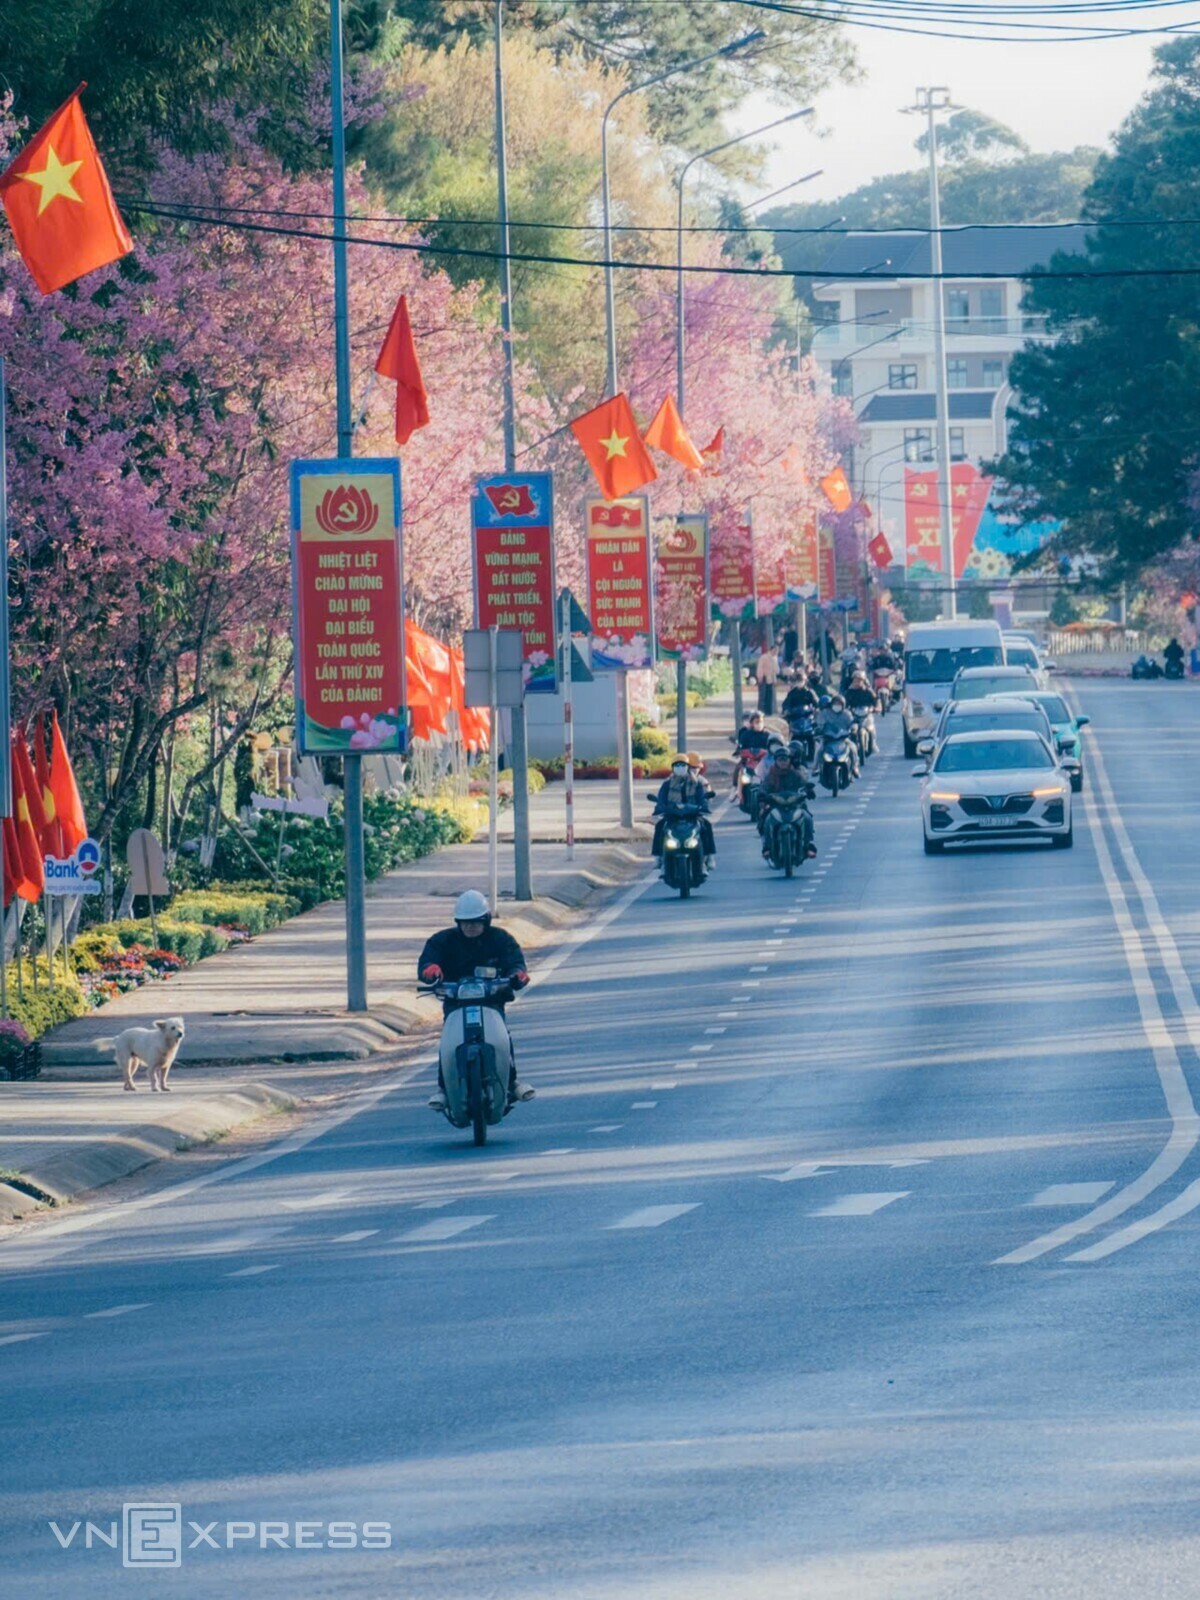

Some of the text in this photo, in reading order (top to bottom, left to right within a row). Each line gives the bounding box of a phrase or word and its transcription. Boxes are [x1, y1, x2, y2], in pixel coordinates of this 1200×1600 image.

[500, 529, 526, 546] ĐẢNG
[319, 551, 378, 571] NHIỆT LIỆT
[315, 573, 383, 591] CHÀO MỪNG
[329, 596, 371, 616] ĐẠI HỘI
[488, 591, 511, 606] PHÁT
[326, 615, 374, 638] ĐẠI BIỂU
[496, 610, 536, 628] DÂN TỘC
[316, 638, 381, 659] TOÀN QUỐC
[341, 663, 364, 680] THỨ
[365, 665, 384, 680] XIV
[321, 684, 383, 702] CỦA ĐẢNG!
